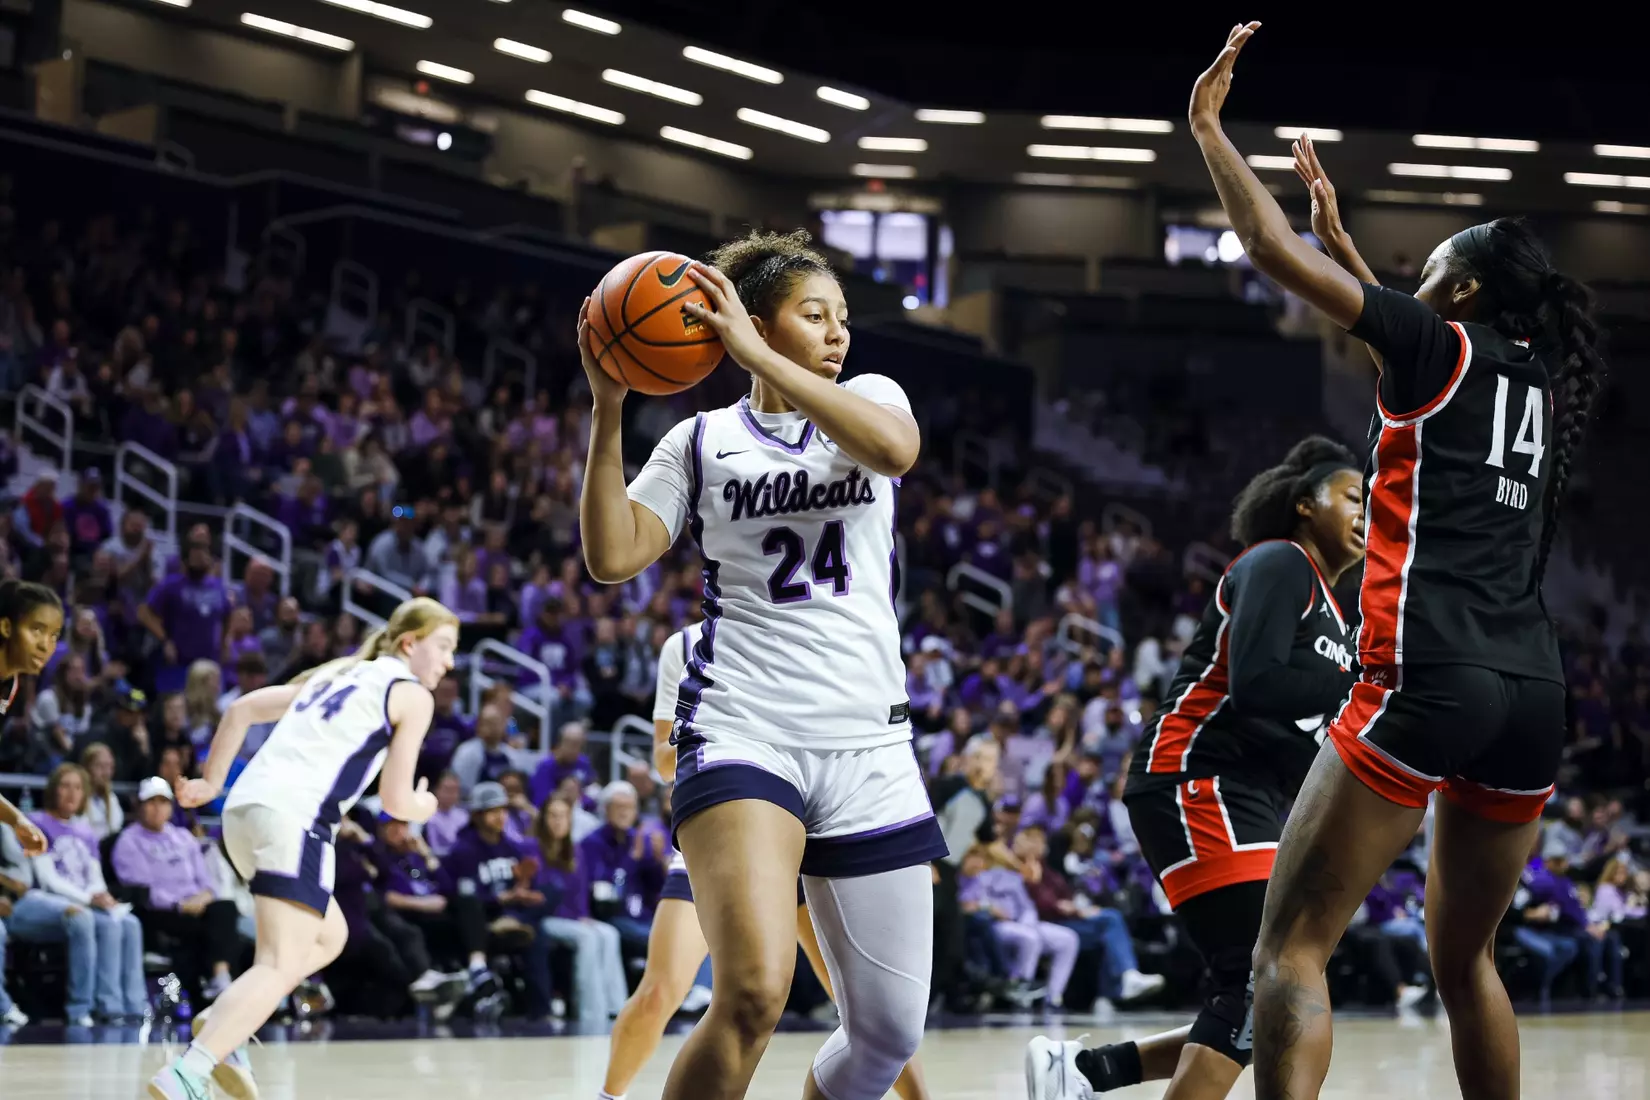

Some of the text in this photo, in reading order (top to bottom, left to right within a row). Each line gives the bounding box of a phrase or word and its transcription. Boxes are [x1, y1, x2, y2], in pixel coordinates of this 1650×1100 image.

[1485, 373, 1545, 478] 14
[723, 465, 876, 522] Wildcats
[1495, 475, 1528, 510] BYRD
[761, 519, 852, 604] 24
